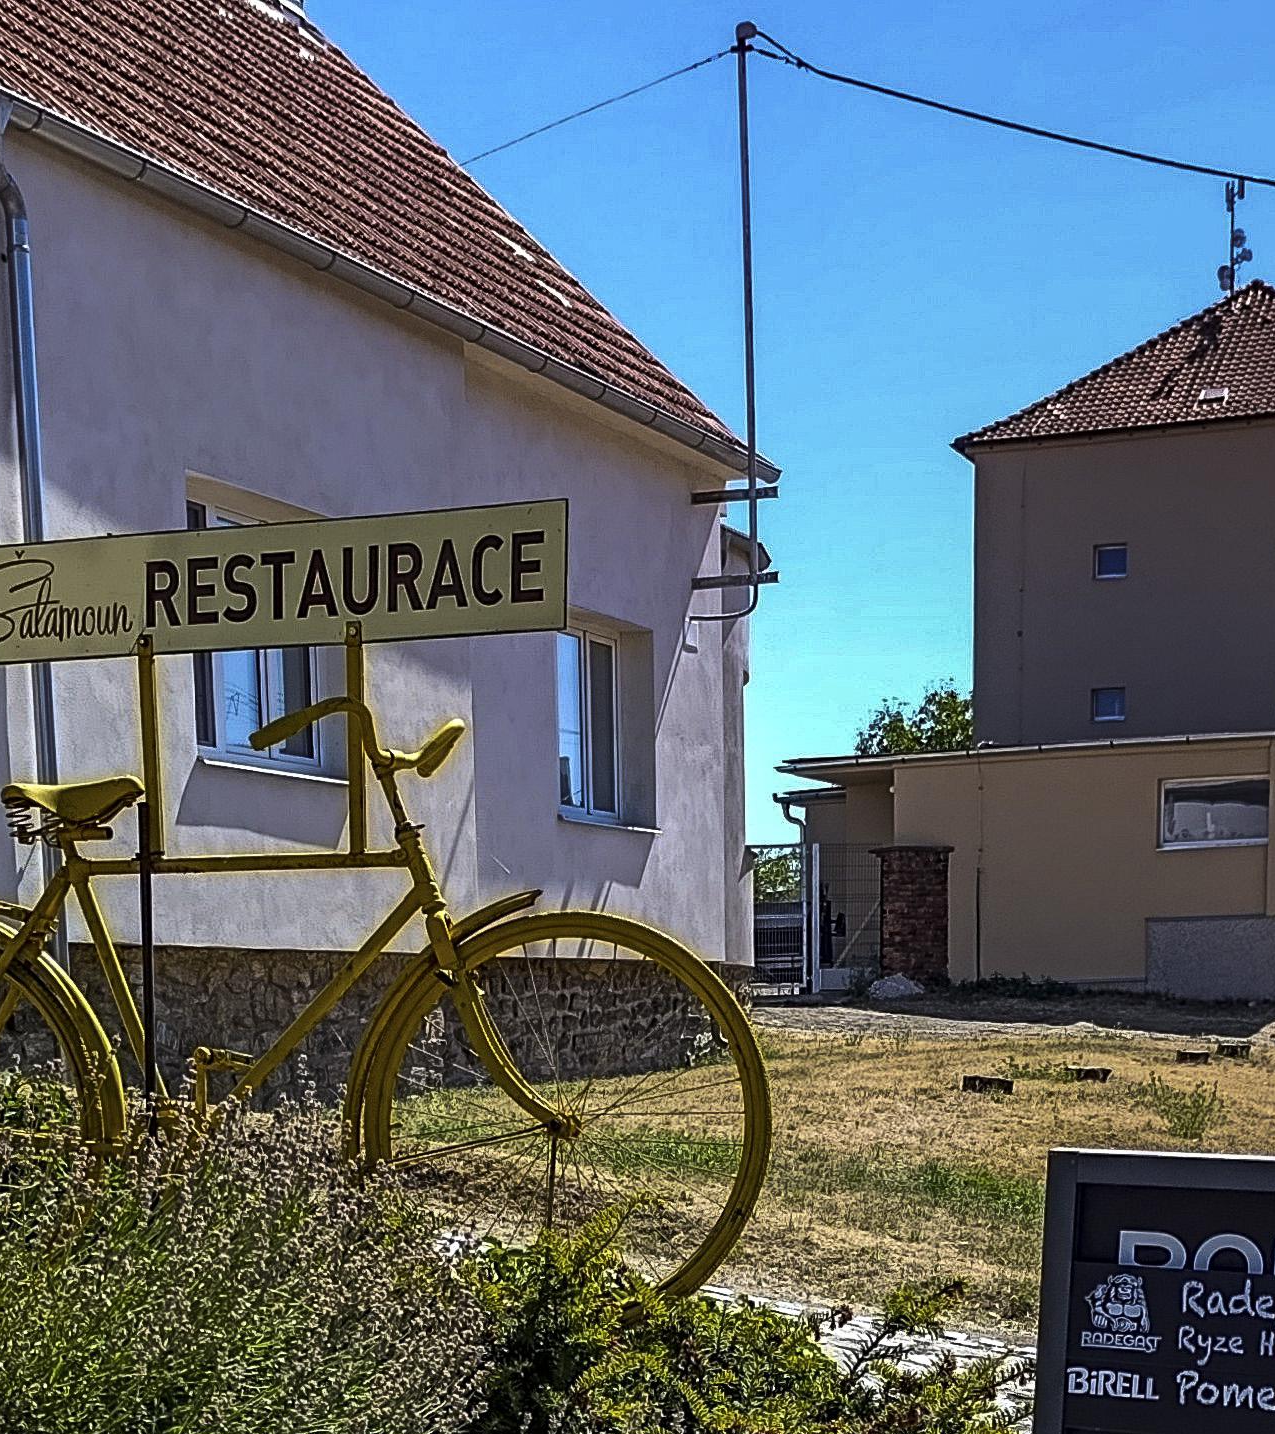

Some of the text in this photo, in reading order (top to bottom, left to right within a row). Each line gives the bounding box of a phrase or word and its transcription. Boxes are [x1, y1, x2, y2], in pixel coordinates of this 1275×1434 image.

[144, 530, 545, 628] RESTAURACE
[1081, 1332, 1162, 1352] RADEGAST
[1178, 1326, 1244, 1366] Ryze
